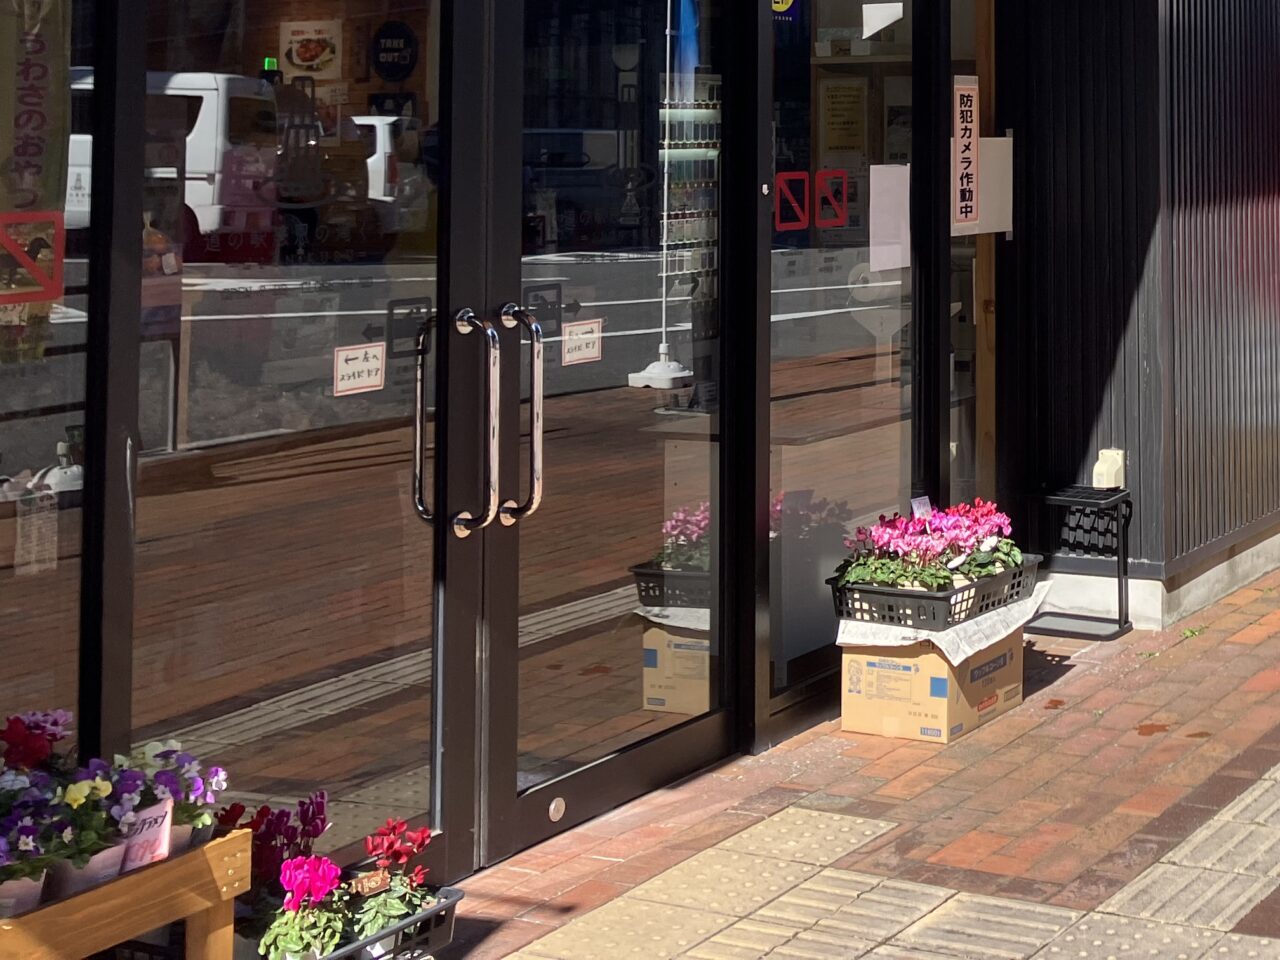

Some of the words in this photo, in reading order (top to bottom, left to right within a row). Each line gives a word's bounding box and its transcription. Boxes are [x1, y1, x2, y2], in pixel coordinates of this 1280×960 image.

[380, 38, 405, 49] TAKE
[379, 52, 400, 62] OUT
[959, 93, 974, 219] 防犯カメラ作動中
